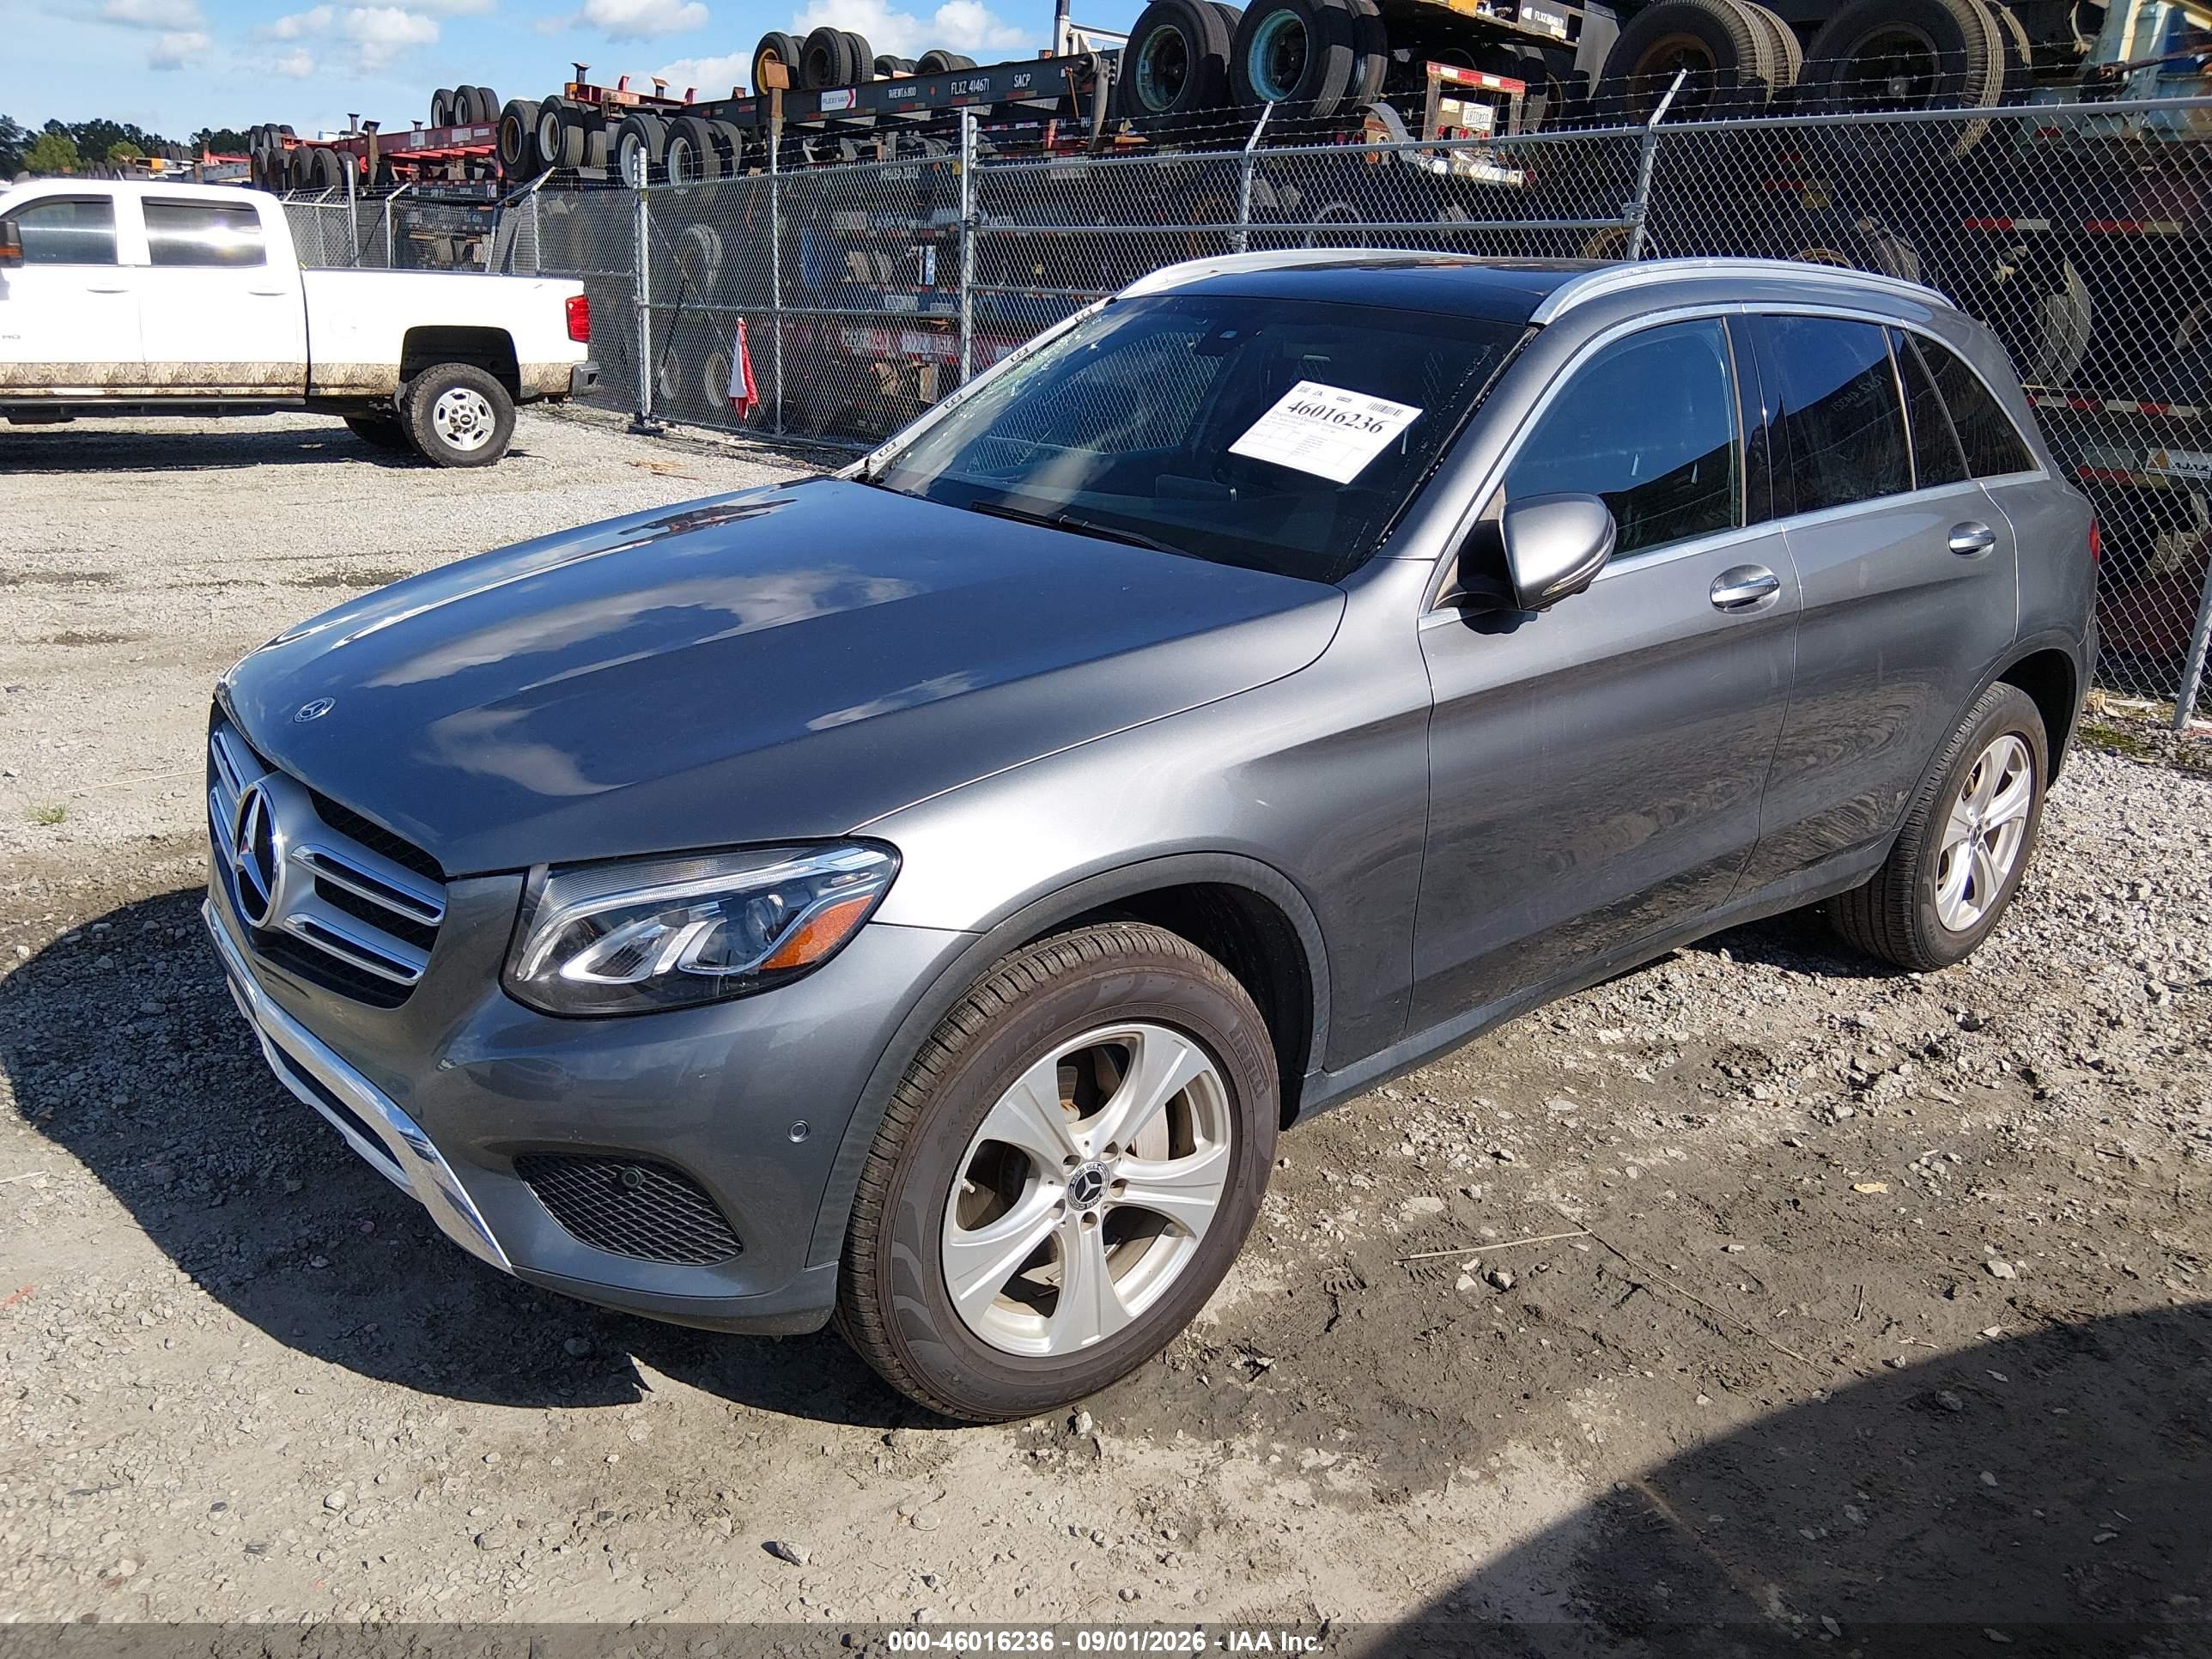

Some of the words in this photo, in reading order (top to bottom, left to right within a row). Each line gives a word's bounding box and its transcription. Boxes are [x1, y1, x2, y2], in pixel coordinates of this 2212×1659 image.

[951, 80, 967, 95] FLXZ
[1013, 73, 1031, 88] SACP
[1287, 399, 1389, 434] 46016236
